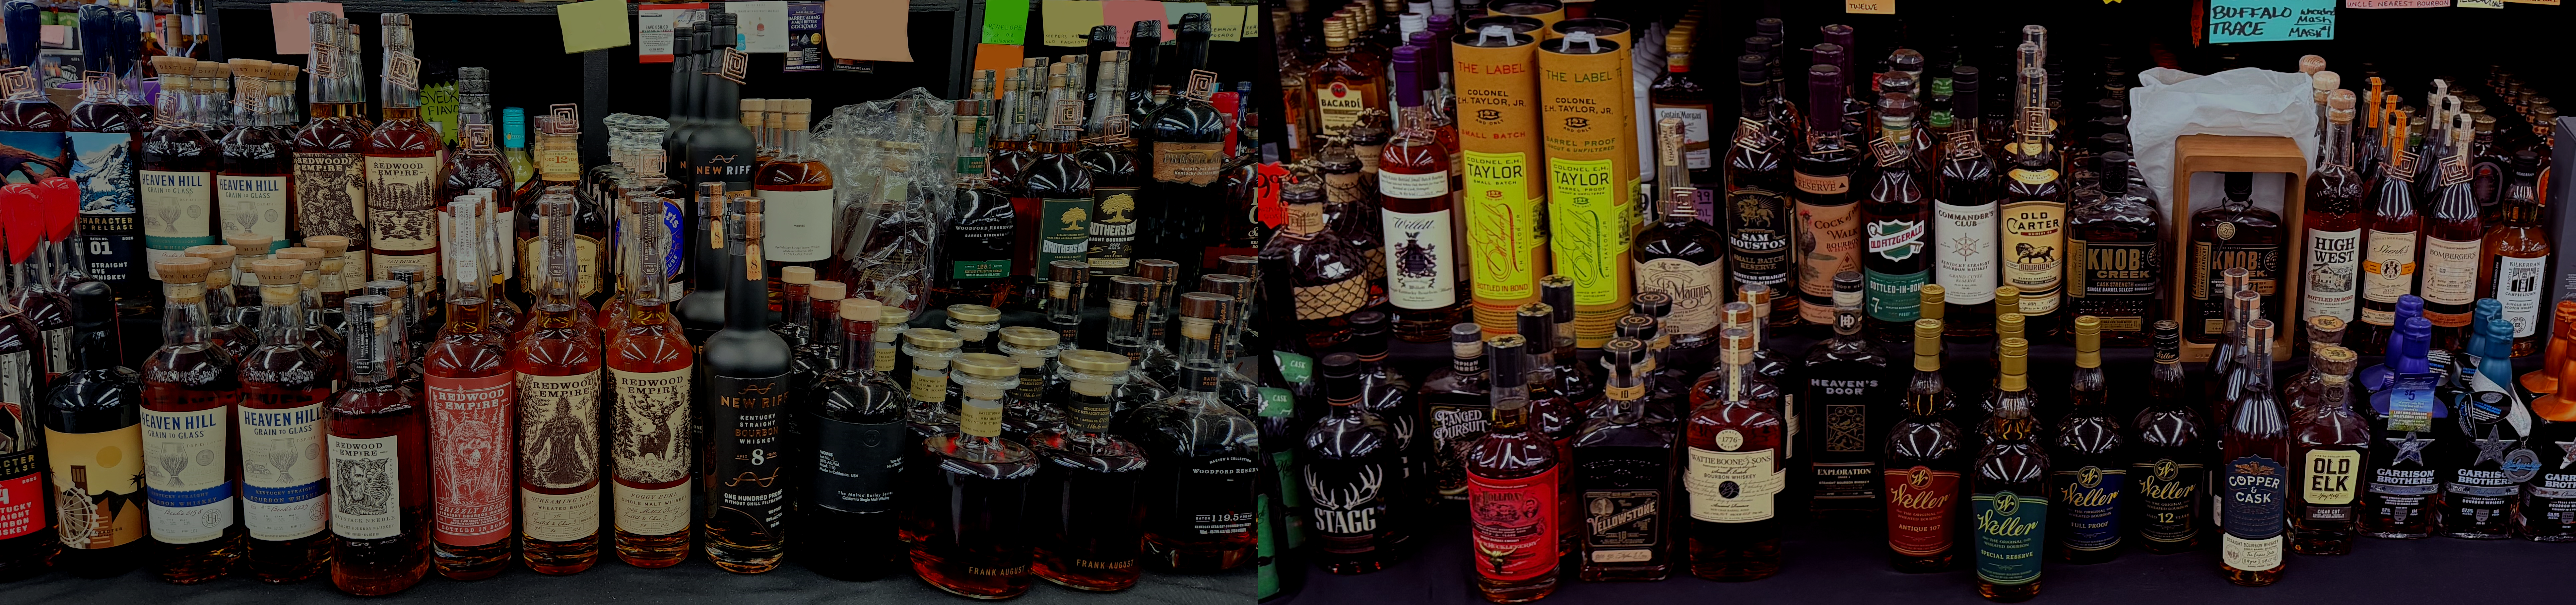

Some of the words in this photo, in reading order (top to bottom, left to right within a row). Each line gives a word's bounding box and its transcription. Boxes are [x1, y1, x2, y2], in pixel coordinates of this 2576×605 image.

[2212, 5, 2292, 19] BUFFALO
[2210, 21, 2267, 36] TRACE
[1458, 62, 1479, 74] THE
[1486, 64, 1526, 75] LABEL
[1546, 70, 1567, 82] THE
[1575, 72, 1613, 83] LABEL
[1321, 99, 1360, 108] BACARDÍ
[1584, 138, 1616, 147] PROOF
[696, 166, 723, 175] NEW
[726, 165, 751, 174] RIFF
[1468, 163, 1523, 179] TAYLOR
[142, 173, 175, 186] HEAVEN
[178, 174, 202, 186] HILL
[1554, 170, 1610, 186] TAYLOR
[220, 179, 252, 191] HEAVEN
[256, 180, 278, 191] HILL
[1939, 210, 1994, 221] COMMANDER'S
[1393, 217, 1434, 231] Willett
[1814, 217, 1844, 230] COCK
[2007, 218, 2060, 234] CARTER
[1742, 233, 1769, 241] SAM
[1827, 227, 1858, 240] WALK
[1882, 225, 1922, 247] FITZGERALD
[90, 241, 112, 255] 01
[1043, 239, 1078, 253] BROTHER'S
[1730, 236, 1786, 250] HOUSTON
[2314, 237, 2355, 250] HIGH
[2373, 242, 2408, 255] Shenk's
[1757, 255, 1784, 264] BATCH
[2087, 248, 2141, 270] KNOB
[2314, 250, 2354, 263] WEST
[1477, 283, 1500, 292] BOTTLED
[1510, 283, 1528, 292] BOND
[1290, 360, 1305, 369] CASK
[533, 378, 594, 389] REDWOOD
[1811, 379, 1878, 388] HEAVEN'S
[438, 389, 504, 401] REDWOOD
[539, 388, 590, 397] EMPIRE
[445, 399, 498, 410] EMPIRE
[721, 395, 756, 409] NEW
[142, 411, 180, 430] HEAVEN
[185, 413, 216, 430] HILL
[244, 411, 291, 427] HEAVEN
[296, 407, 321, 425] HILL
[1434, 409, 1483, 428] FANGED
[148, 430, 166, 438] GRAIN
[178, 431, 204, 439] GLASS
[289, 425, 312, 435] GLASS
[1433, 420, 1492, 451] PURSUIT
[751, 449, 764, 465] 8
[1691, 454, 1715, 464] WATTIE
[1752, 455, 1771, 464] SONS
[1817, 467, 1872, 476] EXPLORATION
[2313, 458, 2349, 474] OLD
[2377, 468, 2435, 477] GARRISON
[2229, 476, 2280, 489] COPPER
[2312, 476, 2349, 491] ELK
[2377, 476, 2435, 484] BROTHERS
[2139, 475, 2196, 501] Weller
[579, 491, 596, 502] TITAN
[1890, 483, 1950, 509] Weller
[2060, 483, 2120, 507] Weller
[2235, 492, 2272, 504] CASK
[439, 505, 480, 514] GRIZZLY
[482, 500, 506, 512] BEAST
[490, 505, 506, 514] WHISKEY
[570, 500, 593, 509] BOURBON
[335, 514, 363, 523] HAYSTACK
[1314, 507, 1376, 533] STAGG
[1587, 499, 1656, 536] YELLOWSTONE
[1977, 509, 2039, 536] Weller
[2158, 513, 2174, 523] 12
[491, 520, 505, 529] BOND
[1981, 549, 2004, 560] SPECIAL
[2006, 551, 2033, 560] RESERVE
[1077, 559, 1105, 569] FRANK
[1108, 559, 1134, 569] AUGUST
[969, 566, 996, 576] FRANK
[1000, 566, 1025, 575] AUGUST
